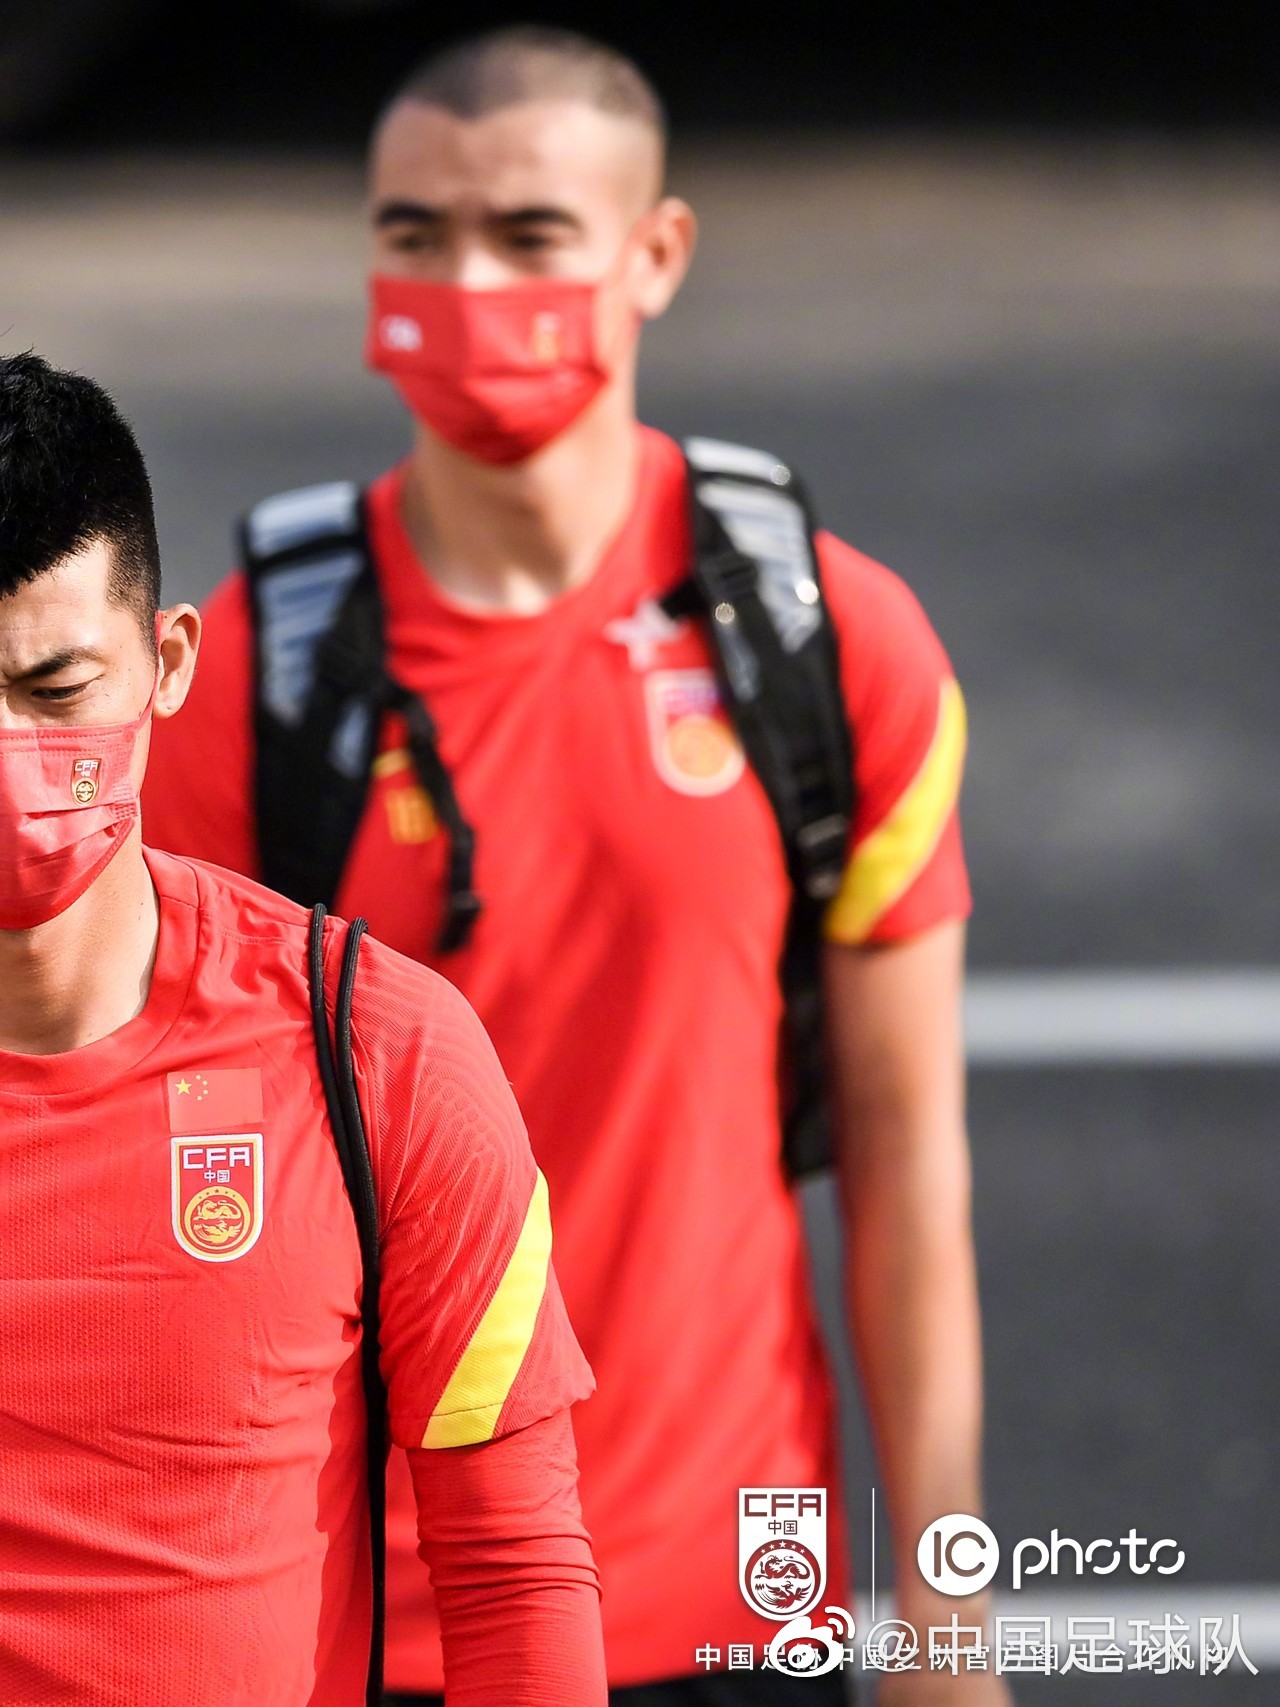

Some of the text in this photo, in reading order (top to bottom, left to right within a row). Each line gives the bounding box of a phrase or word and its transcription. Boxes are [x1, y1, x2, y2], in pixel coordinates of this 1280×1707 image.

[75, 761, 99, 772] CFA
[183, 1147, 250, 1170] CFA
[204, 1169, 230, 1184] 中国
